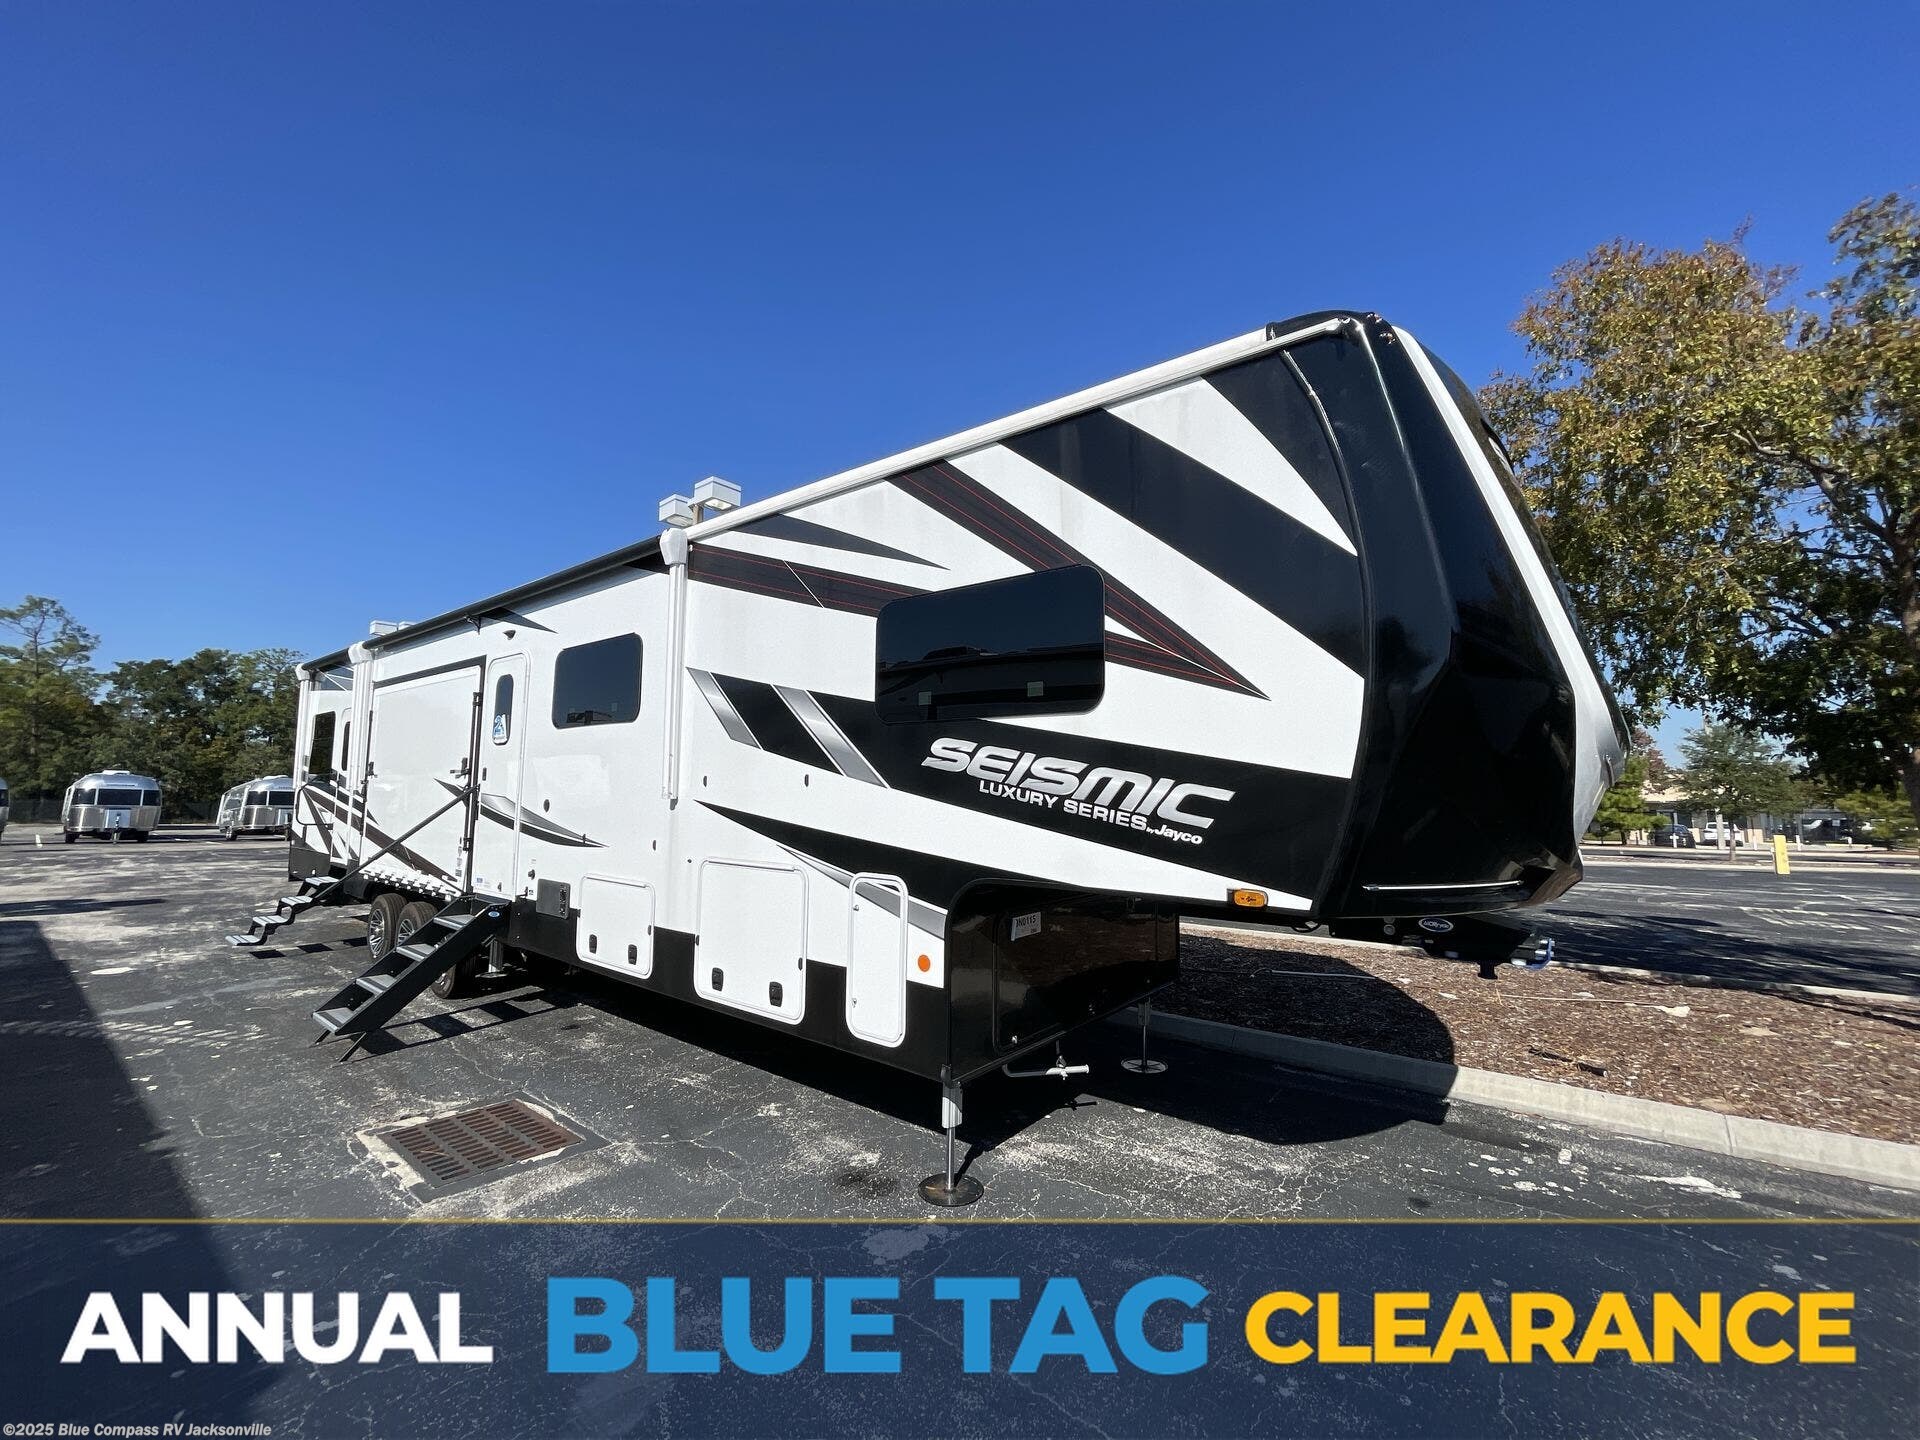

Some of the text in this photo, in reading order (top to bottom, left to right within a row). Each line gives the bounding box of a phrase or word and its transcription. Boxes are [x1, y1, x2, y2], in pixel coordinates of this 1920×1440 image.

[921, 737, 1236, 829] SEISMIC
[979, 780, 1059, 808] LUXURY
[1063, 799, 1147, 831] SERIES
[1155, 824, 1202, 844] Jayco
